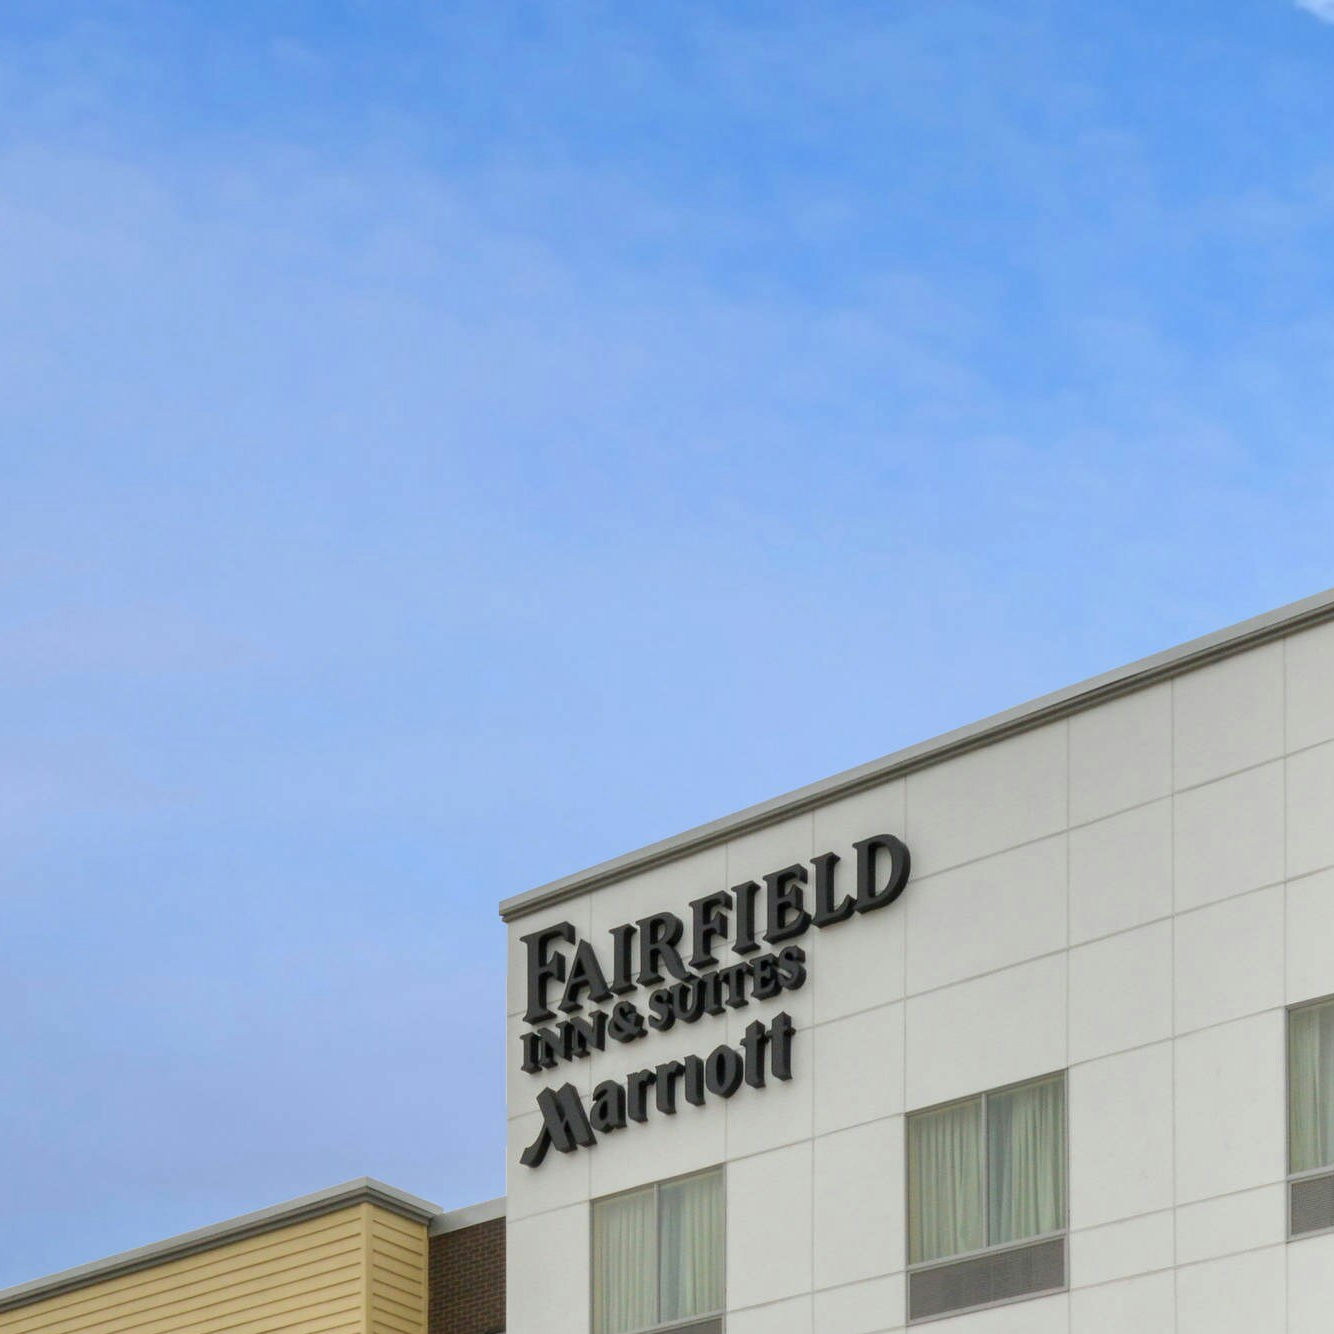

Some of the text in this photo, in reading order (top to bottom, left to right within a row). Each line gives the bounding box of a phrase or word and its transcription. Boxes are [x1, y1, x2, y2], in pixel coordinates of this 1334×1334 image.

[519, 833, 911, 1025] FAIRFIELD
[648, 945, 807, 1032] SUITES
[519, 1011, 796, 1168] Marriott
